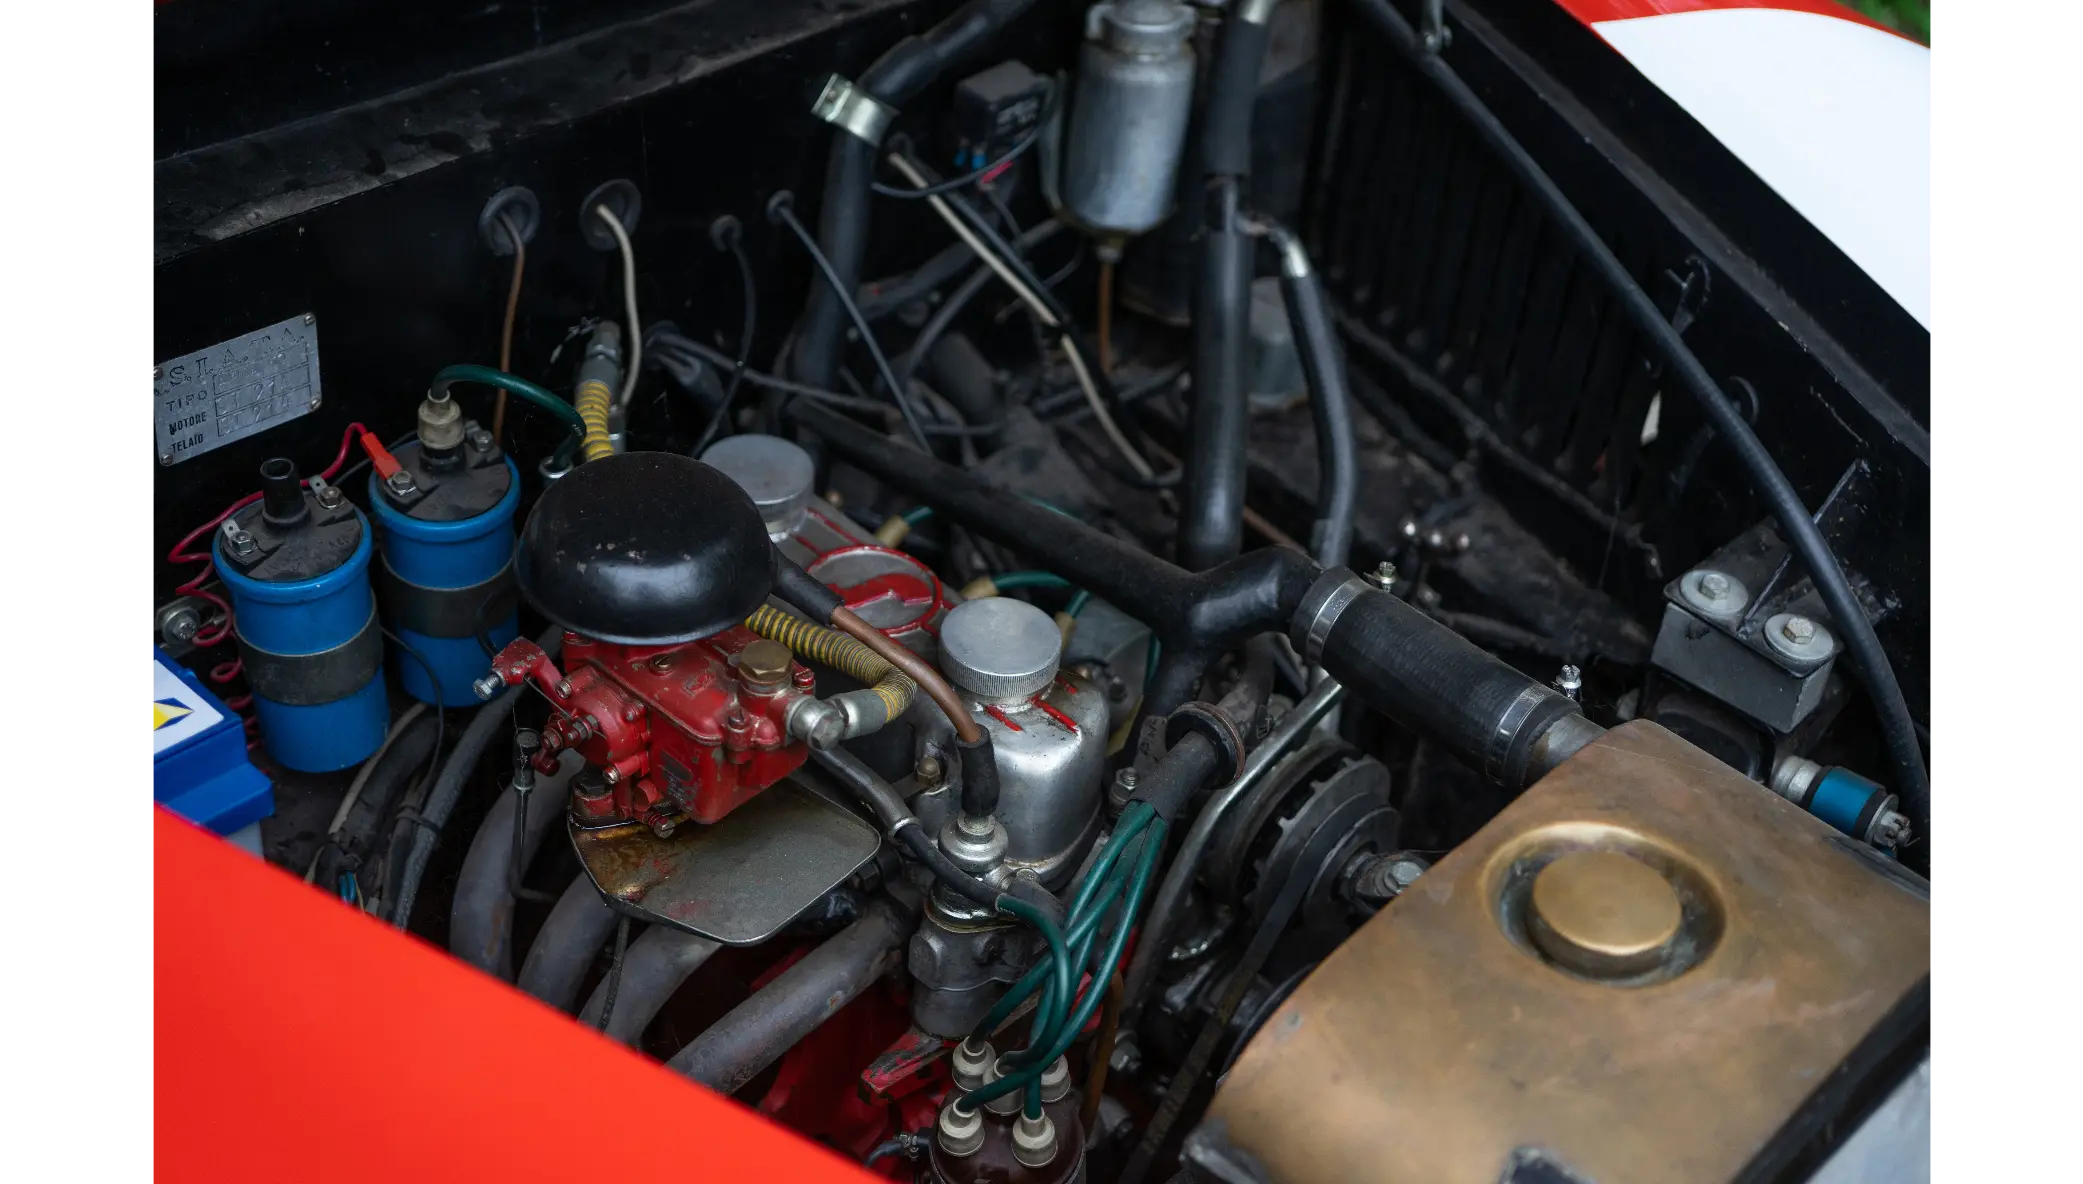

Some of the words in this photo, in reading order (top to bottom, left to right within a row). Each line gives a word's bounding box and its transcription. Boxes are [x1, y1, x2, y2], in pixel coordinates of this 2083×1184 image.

[166, 389, 208, 411] TIPO
[169, 411, 207, 435] MOTORE
[170, 433, 204, 453] TELAIO
